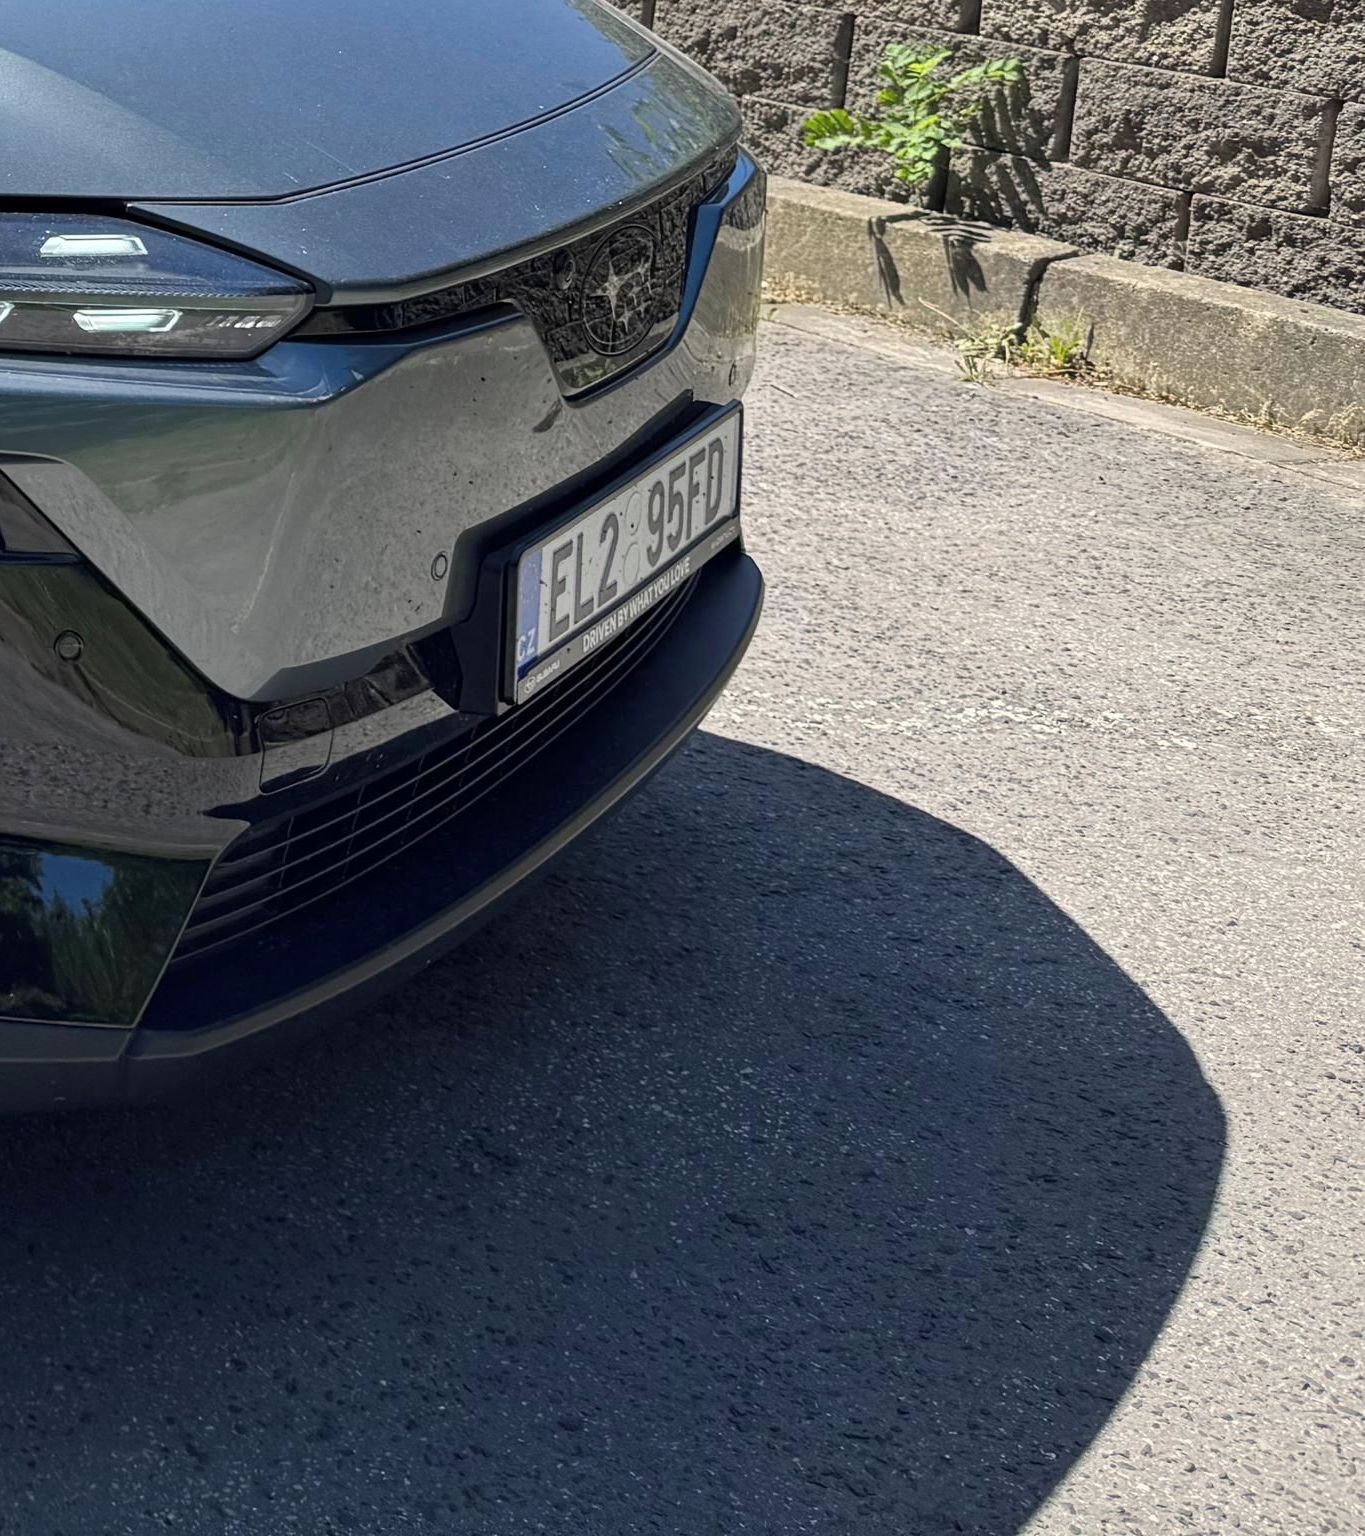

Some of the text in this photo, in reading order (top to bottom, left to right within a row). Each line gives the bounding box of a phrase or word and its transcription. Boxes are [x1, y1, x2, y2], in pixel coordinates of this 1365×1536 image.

[549, 437, 723, 642] EL2 95FD
[517, 627, 535, 661] CZ
[583, 556, 690, 652] DRIVEN BY WHAT YOU LOVE
